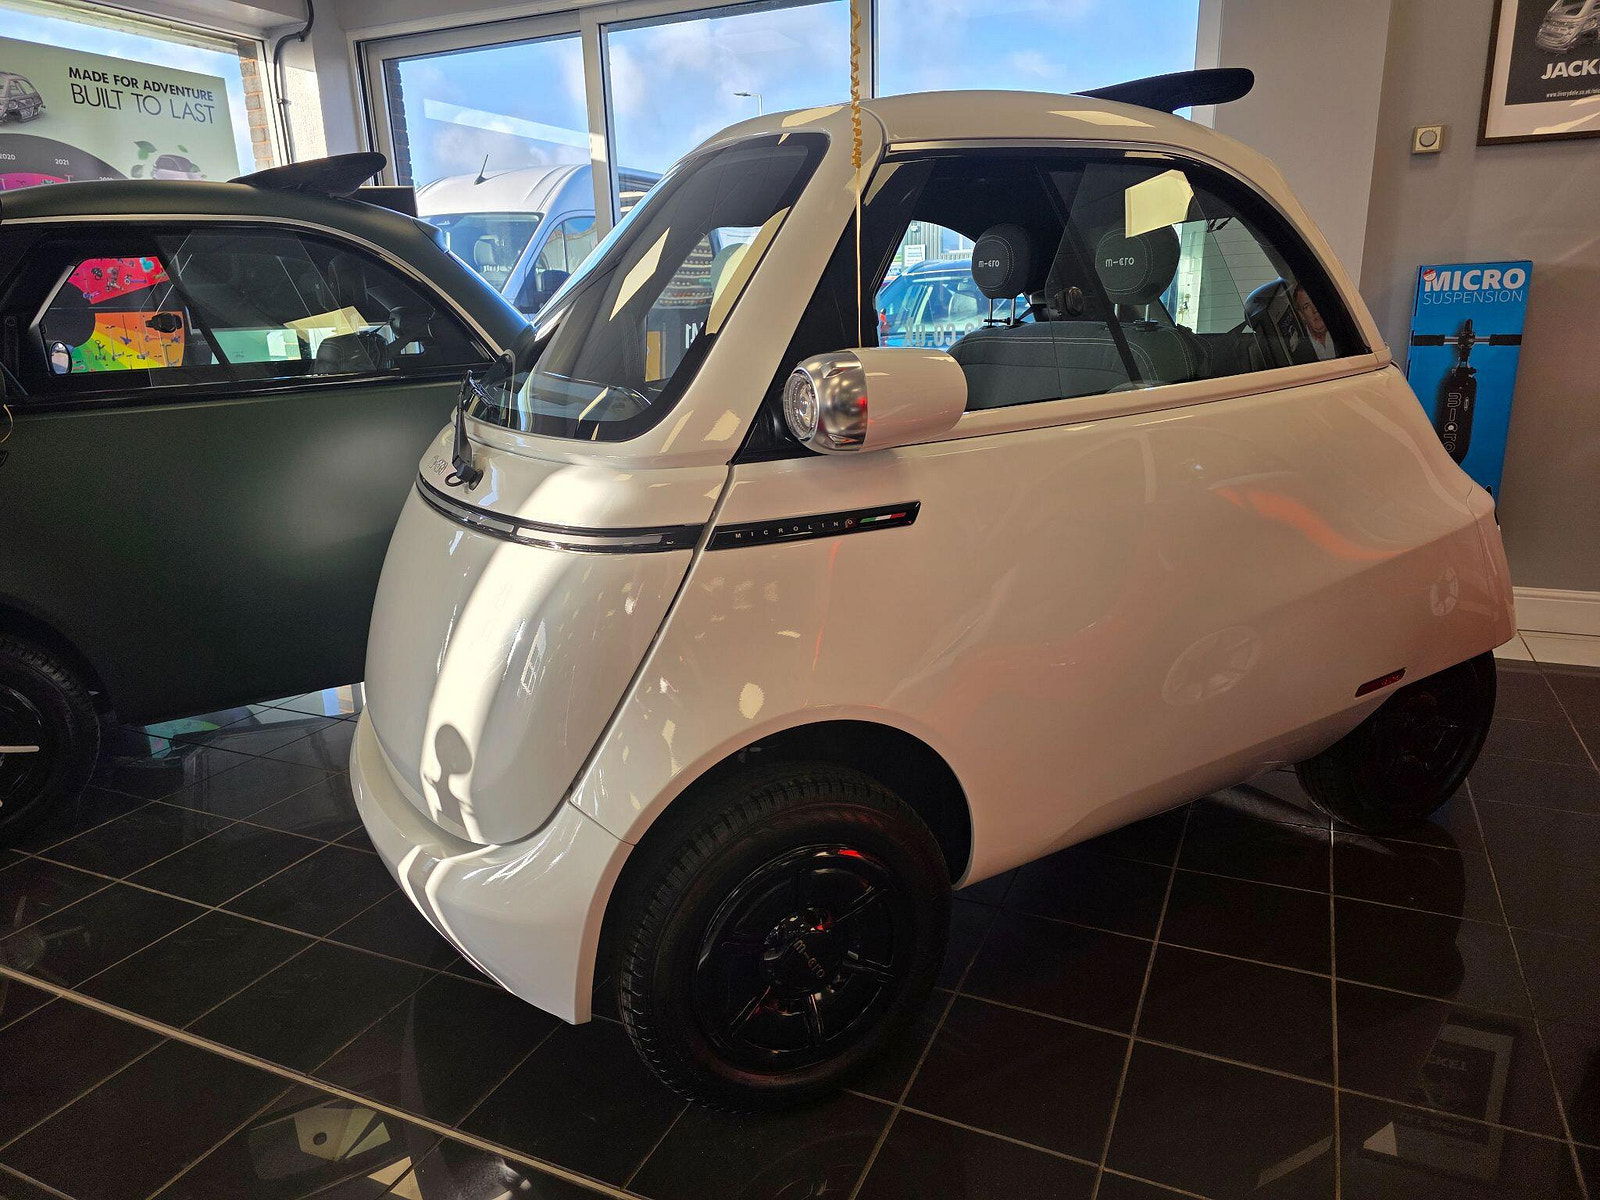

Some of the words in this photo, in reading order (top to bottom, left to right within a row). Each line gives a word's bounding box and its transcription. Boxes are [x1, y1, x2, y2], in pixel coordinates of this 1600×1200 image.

[1541, 58, 1600, 80] JACK
[69, 66, 109, 84] MADE
[114, 74, 139, 90] FOR
[143, 80, 214, 101] ADVENTURE
[71, 83, 123, 110] BUILT
[131, 93, 162, 116] TO
[170, 99, 215, 124] LAST
[55, 158, 70, 166] 2021
[1424, 268, 1526, 292] MICRO
[1423, 290, 1523, 305] SUSPENSION
[735, 518, 853, 539] MICROLINO
